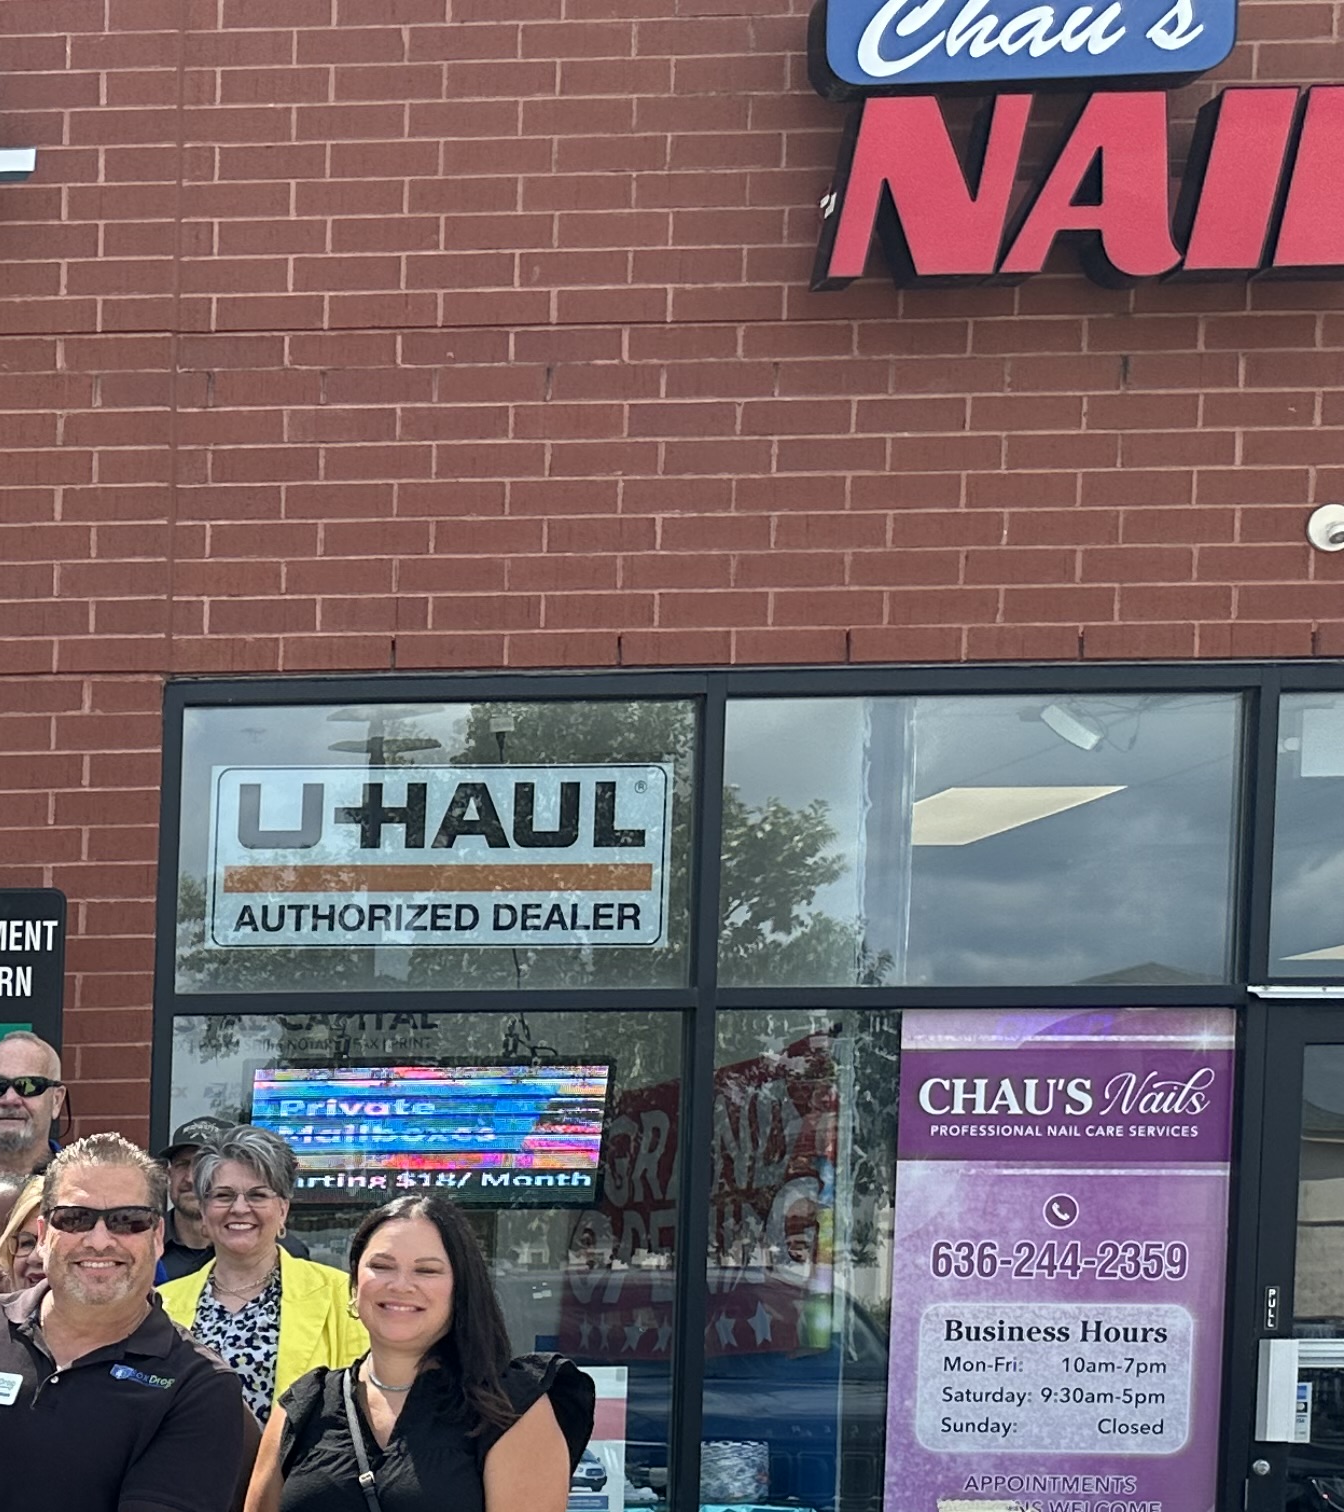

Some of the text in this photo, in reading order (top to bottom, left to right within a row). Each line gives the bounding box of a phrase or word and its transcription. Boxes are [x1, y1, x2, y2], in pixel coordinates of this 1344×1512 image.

[857, 0, 1204, 78] Chaus
[237, 780, 647, 851] U-HAUL
[233, 902, 643, 933] AUTHORIZED DEALER
[918, 1067, 1216, 1117] CHAU'S Nails
[280, 1099, 436, 1116] Private
[930, 1125, 1199, 1138] PROFESSIONAL NAIL CARE SERVICES
[481, 1171, 592, 1188] Month
[929, 1240, 1190, 1281] 636-244-2359
[1267, 1288, 1277, 1328] PULL
[943, 1319, 1169, 1344] Business Hours
[942, 1356, 1167, 1376] Mon-Fri: 10am-7pm
[941, 1386, 1167, 1407] Saturday: 9:30am-5pm
[940, 1417, 1165, 1438] Sunday: Closed
[963, 1475, 1137, 1495] APPOINTMENTS
